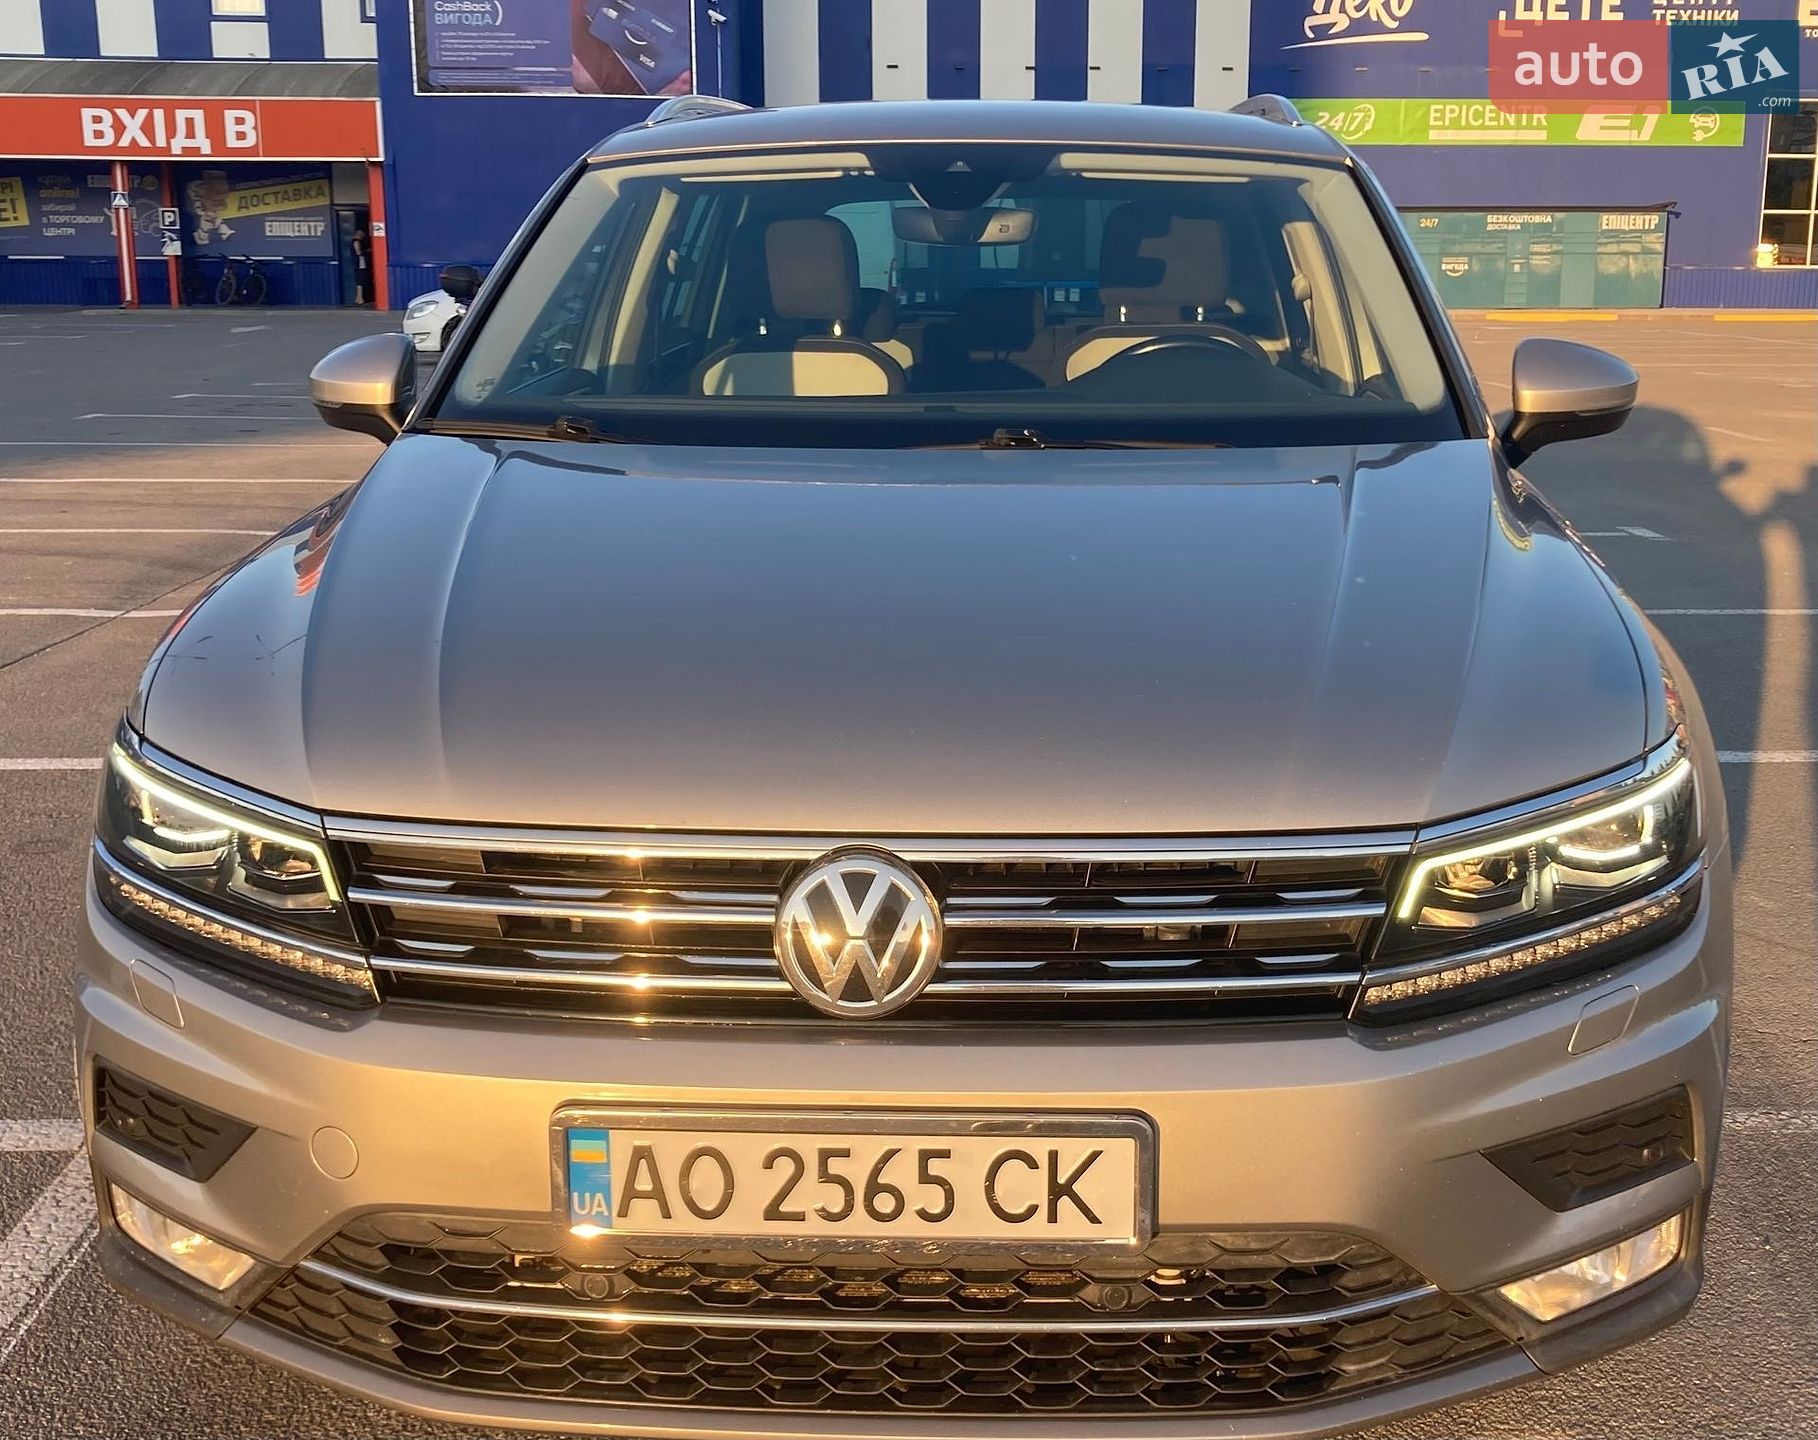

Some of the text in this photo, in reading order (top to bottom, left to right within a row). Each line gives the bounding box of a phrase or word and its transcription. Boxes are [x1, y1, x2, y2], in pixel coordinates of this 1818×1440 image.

[434, 1, 493, 12] CashBack
[434, 13, 493, 26] ВИГОДА
[1429, 105, 1547, 127] EPICENTR
[80, 107, 258, 155] ВХІД В
[237, 183, 327, 212] ДОСТАВКА
[1420, 217, 1439, 228] 24/7
[1487, 214, 1552, 225] БЕЗКОШТОВНА
[1601, 214, 1660, 231] ЕПІЦЕНТР
[617, 1144, 1104, 1227] AO 2565 CK
[572, 1191, 610, 1217] UA
